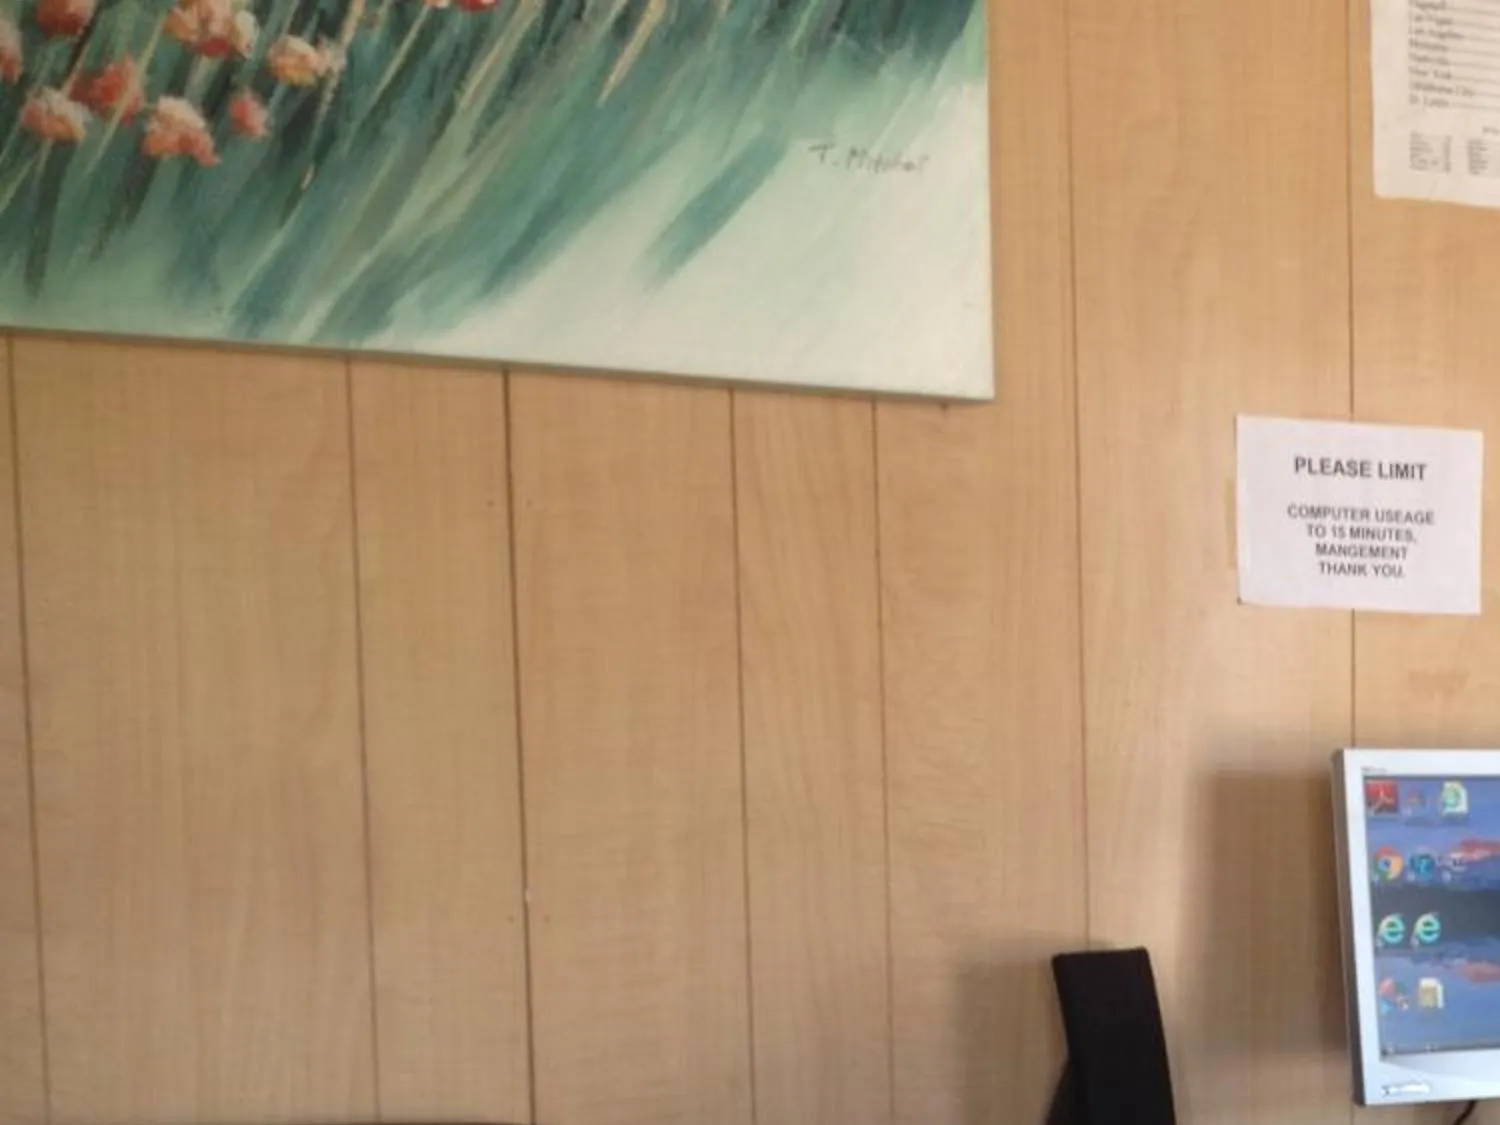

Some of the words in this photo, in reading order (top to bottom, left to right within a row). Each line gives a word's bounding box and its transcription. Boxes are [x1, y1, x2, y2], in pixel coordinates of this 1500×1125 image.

[1294, 456, 1371, 478] PLEASE
[1378, 462, 1427, 481] LIMIT
[1287, 503, 1370, 521] COMPUTER
[1375, 508, 1434, 525] USEAGE
[1307, 523, 1326, 538] TO
[1331, 525, 1346, 539] 15
[1315, 543, 1408, 560] MANGEMENT
[1320, 561, 1367, 577] THANK
